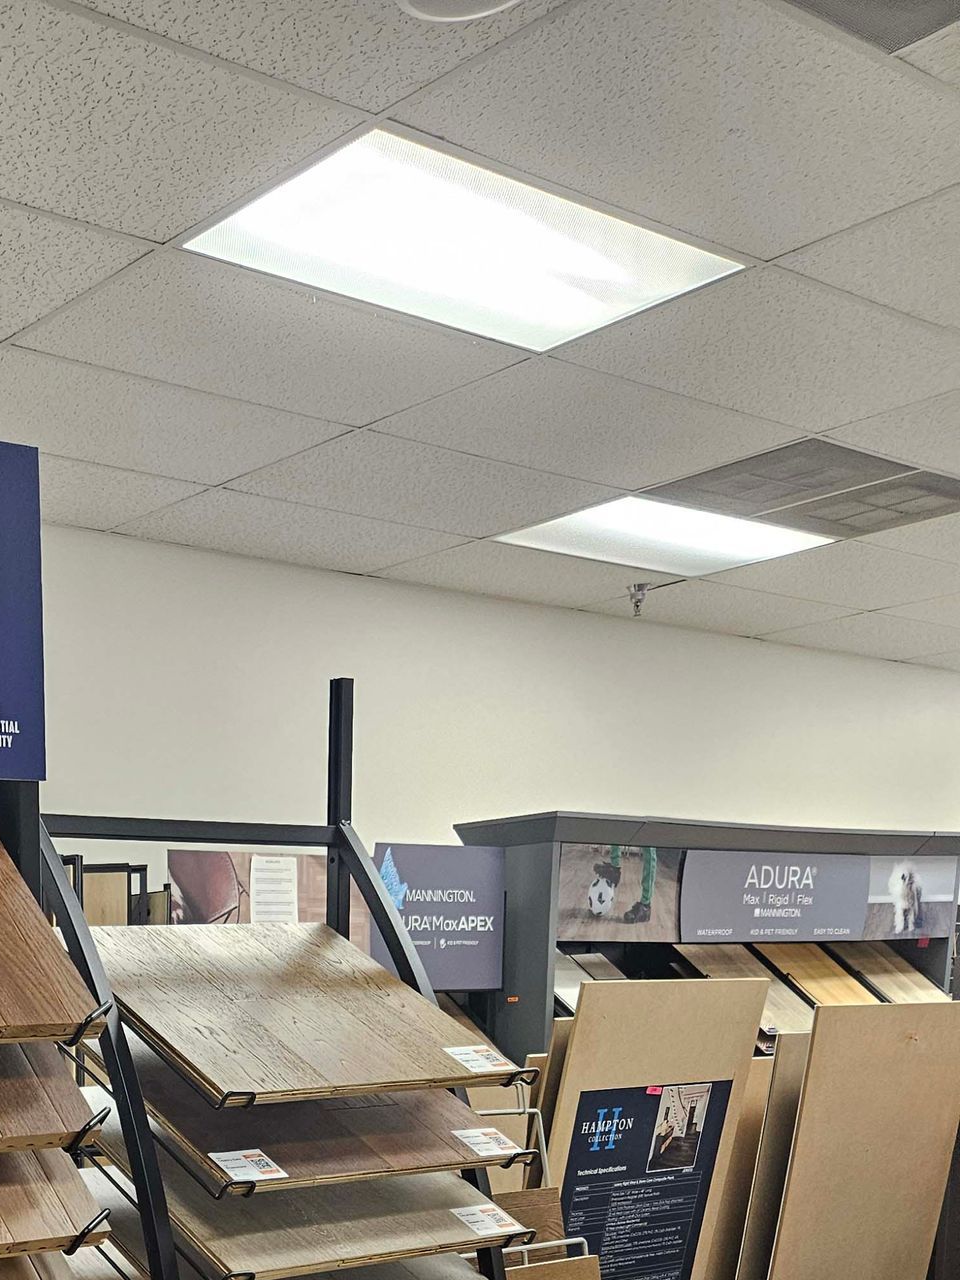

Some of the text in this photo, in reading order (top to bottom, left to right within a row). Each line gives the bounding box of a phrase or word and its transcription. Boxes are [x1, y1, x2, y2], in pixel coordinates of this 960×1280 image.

[742, 893, 813, 907] Max Rigid Flex
[697, 928, 733, 936] WATERPROOF
[581, 1117, 634, 1135] HAMPTON
[588, 1133, 623, 1144] COLLECTION
[577, 1165, 627, 1177] Technical Specifications
